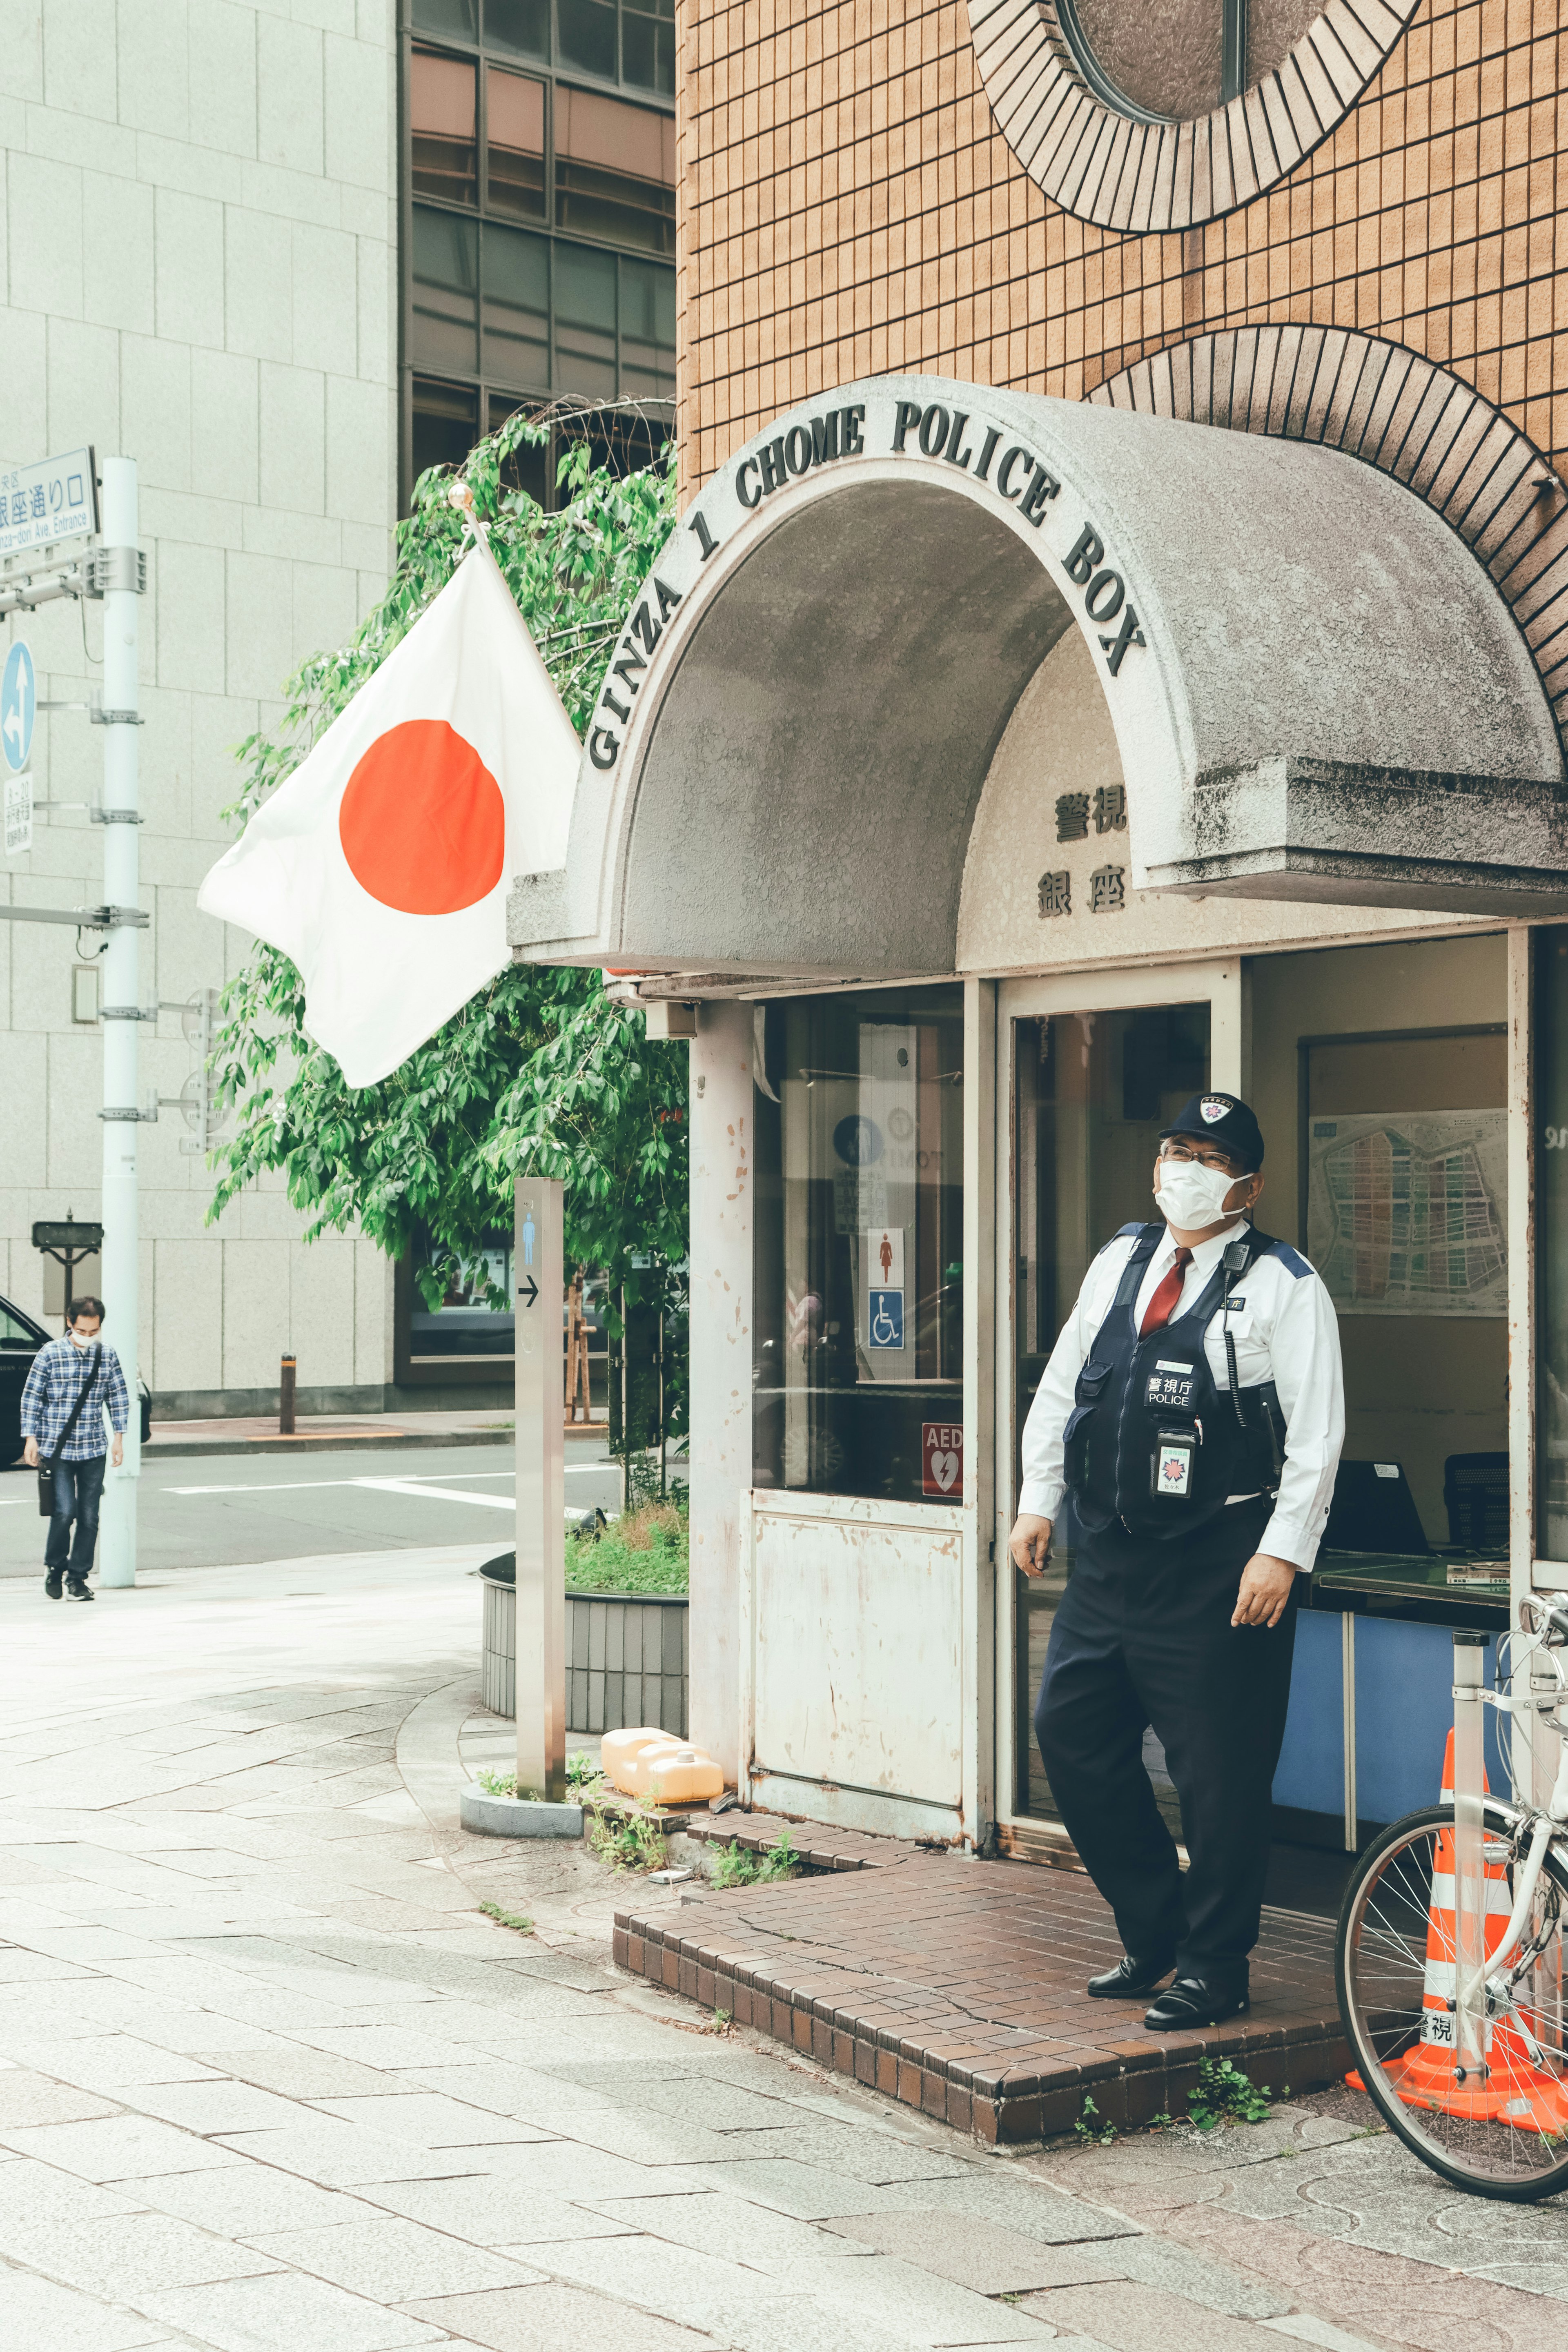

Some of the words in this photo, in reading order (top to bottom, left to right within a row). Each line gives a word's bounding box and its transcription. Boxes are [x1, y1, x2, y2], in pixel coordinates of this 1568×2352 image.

[35, 521, 51, 539] Ave.
[53, 512, 87, 534] Entrance
[590, 577, 682, 769] GINZA
[688, 511, 719, 561] 1
[735, 403, 865, 508] CHOME
[890, 401, 1061, 528] POLICE
[1061, 521, 1147, 677] BOX
[1055, 785, 1127, 843] 警視
[1038, 864, 1125, 918] 銀座
[1148, 1377, 1193, 1395] 警視庁
[1149, 1393, 1189, 1406] POLICE
[927, 1428, 963, 1448] AED
